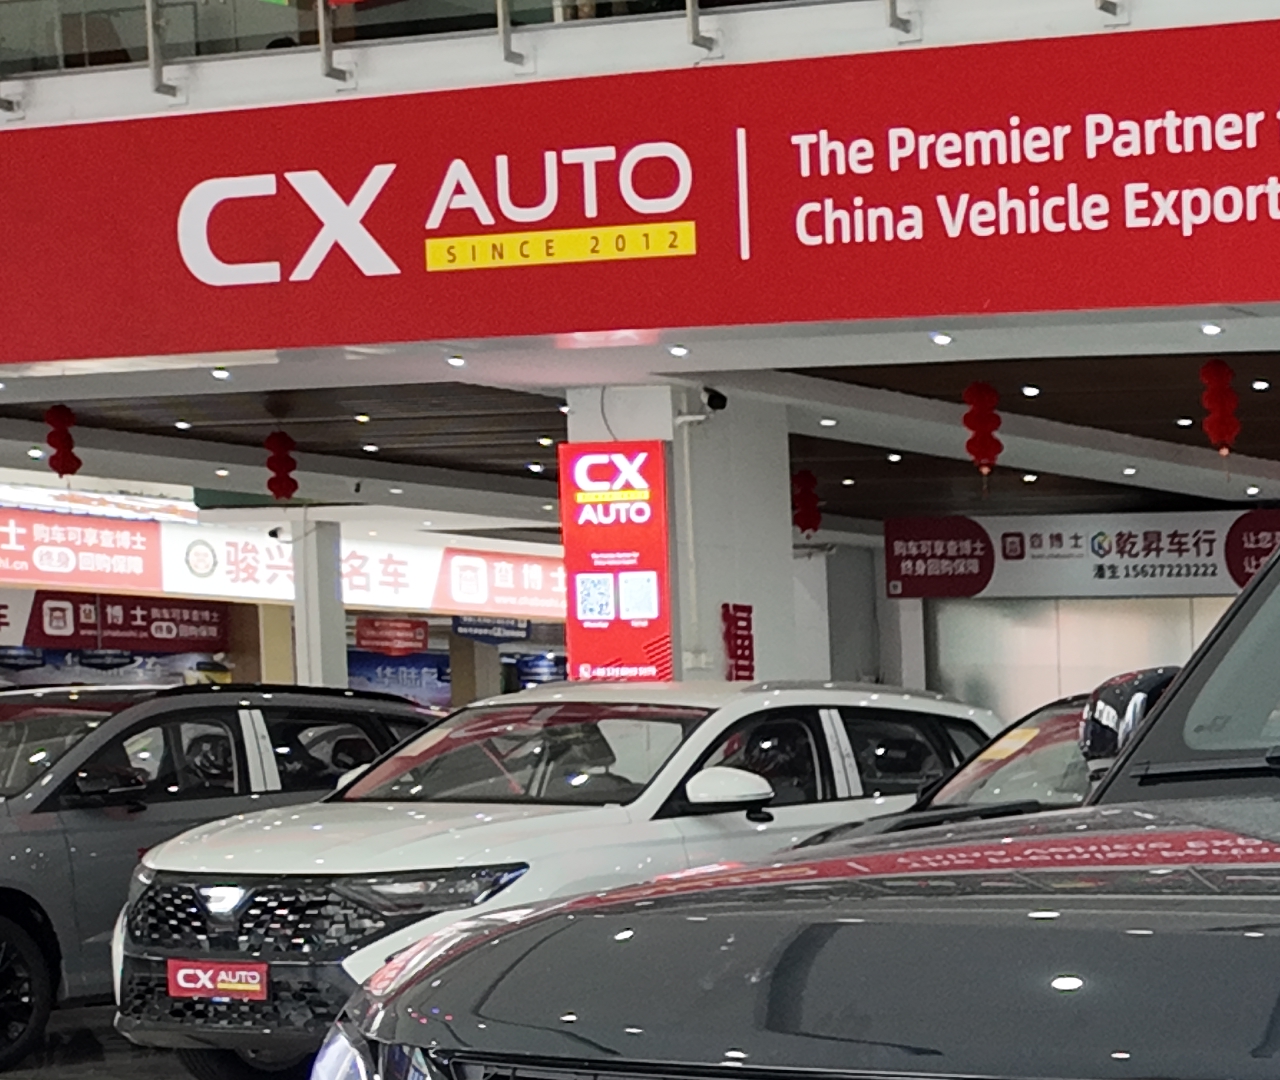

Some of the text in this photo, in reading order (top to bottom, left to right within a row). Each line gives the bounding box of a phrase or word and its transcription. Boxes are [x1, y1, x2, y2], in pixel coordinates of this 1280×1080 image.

[791, 130, 873, 177] The
[888, 116, 1071, 171] Premier
[1085, 107, 1264, 158] Partner
[177, 141, 692, 286] CX AUTO
[796, 197, 924, 246] China
[936, 182, 1109, 238] Vehicle
[446, 230, 679, 264] SINCE 2012
[574, 453, 649, 491] CX
[577, 502, 651, 525] AUTO
[176, 968, 260, 989] CX AUTO
